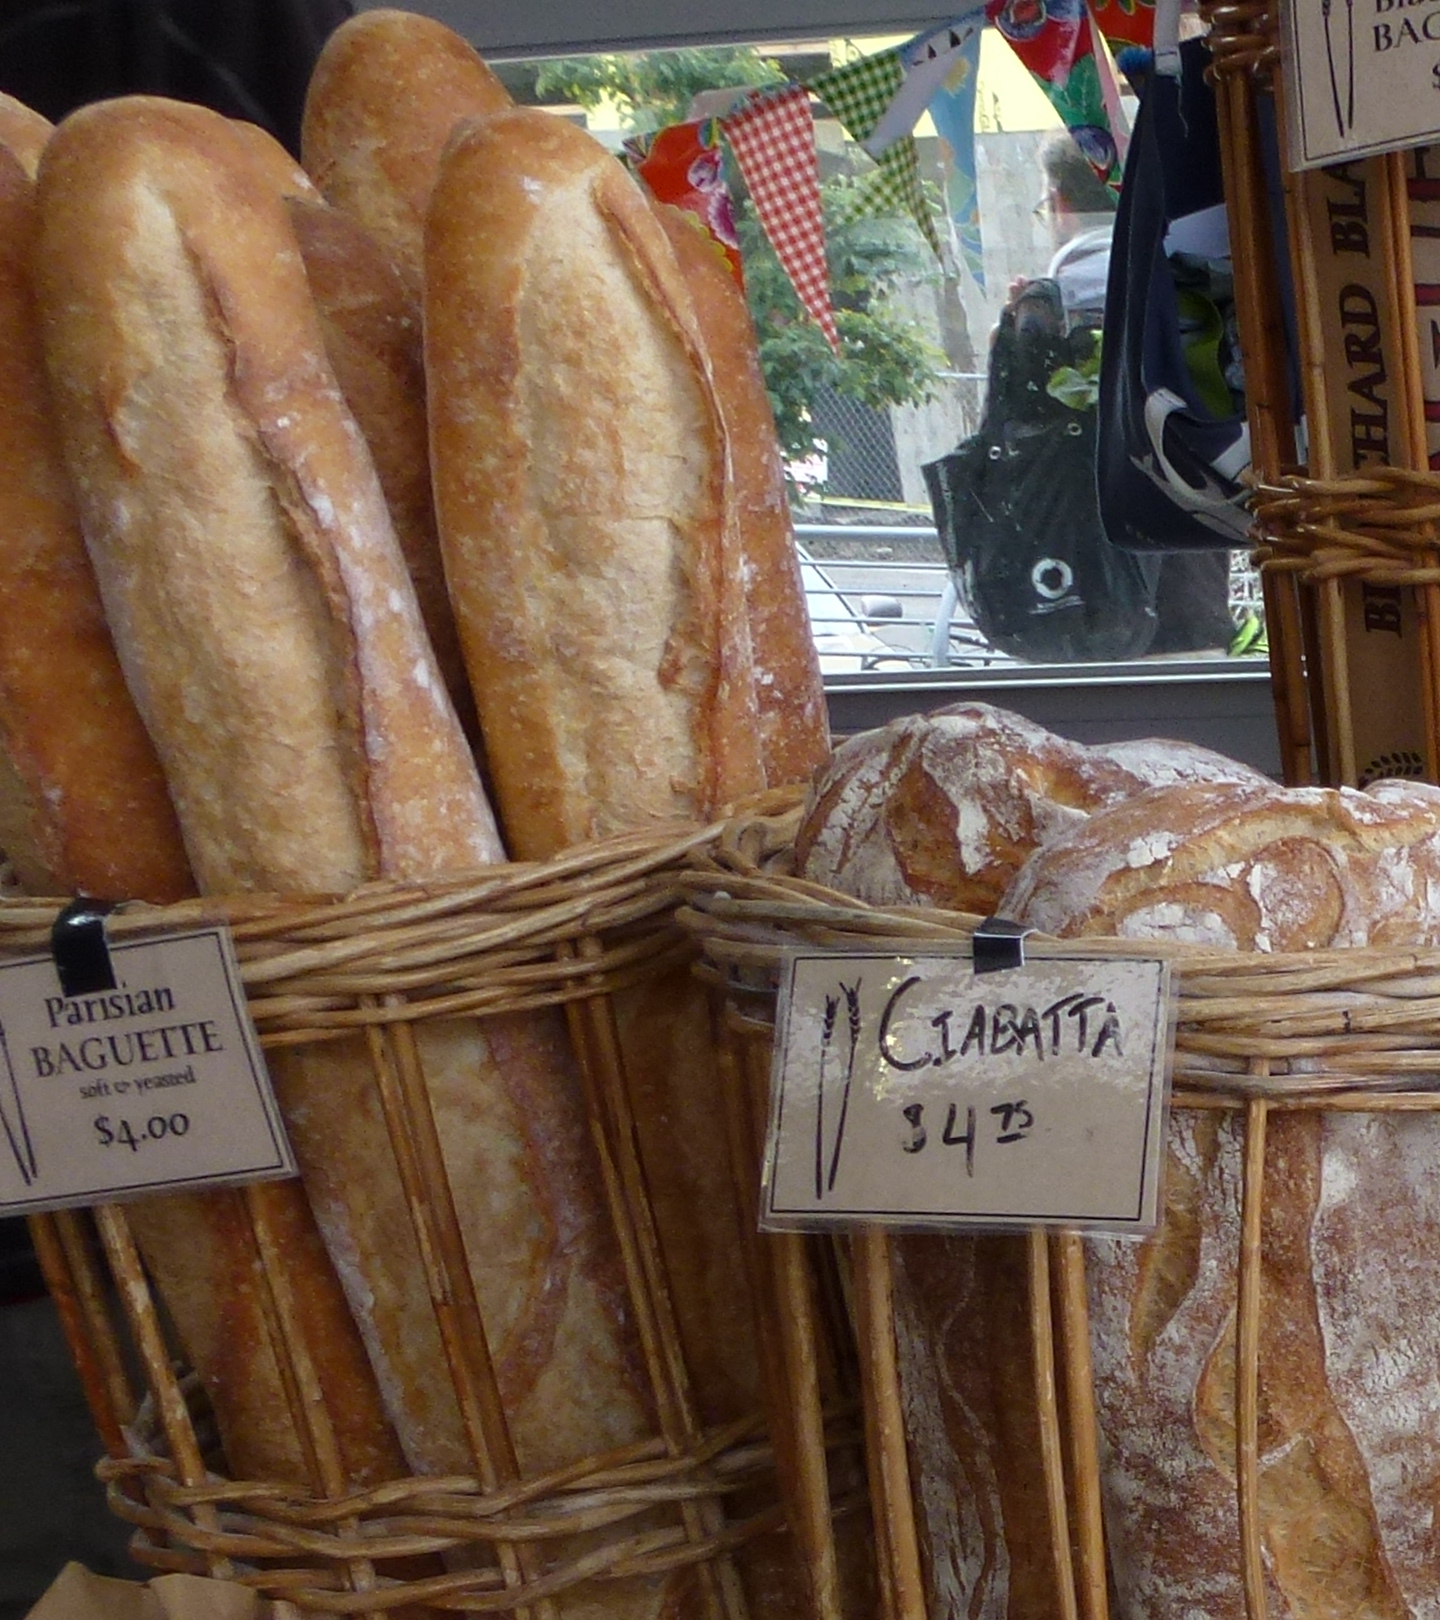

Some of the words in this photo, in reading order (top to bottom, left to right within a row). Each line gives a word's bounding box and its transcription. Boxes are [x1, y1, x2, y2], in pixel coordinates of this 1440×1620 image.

[44, 981, 176, 1029] Parisian
[878, 976, 1124, 1072] CIABATTA
[31, 1020, 224, 1078] BAGUETTE
[79, 1077, 112, 1101] soft
[133, 1064, 198, 1096] yeasted
[93, 1112, 191, 1152] $4.00
